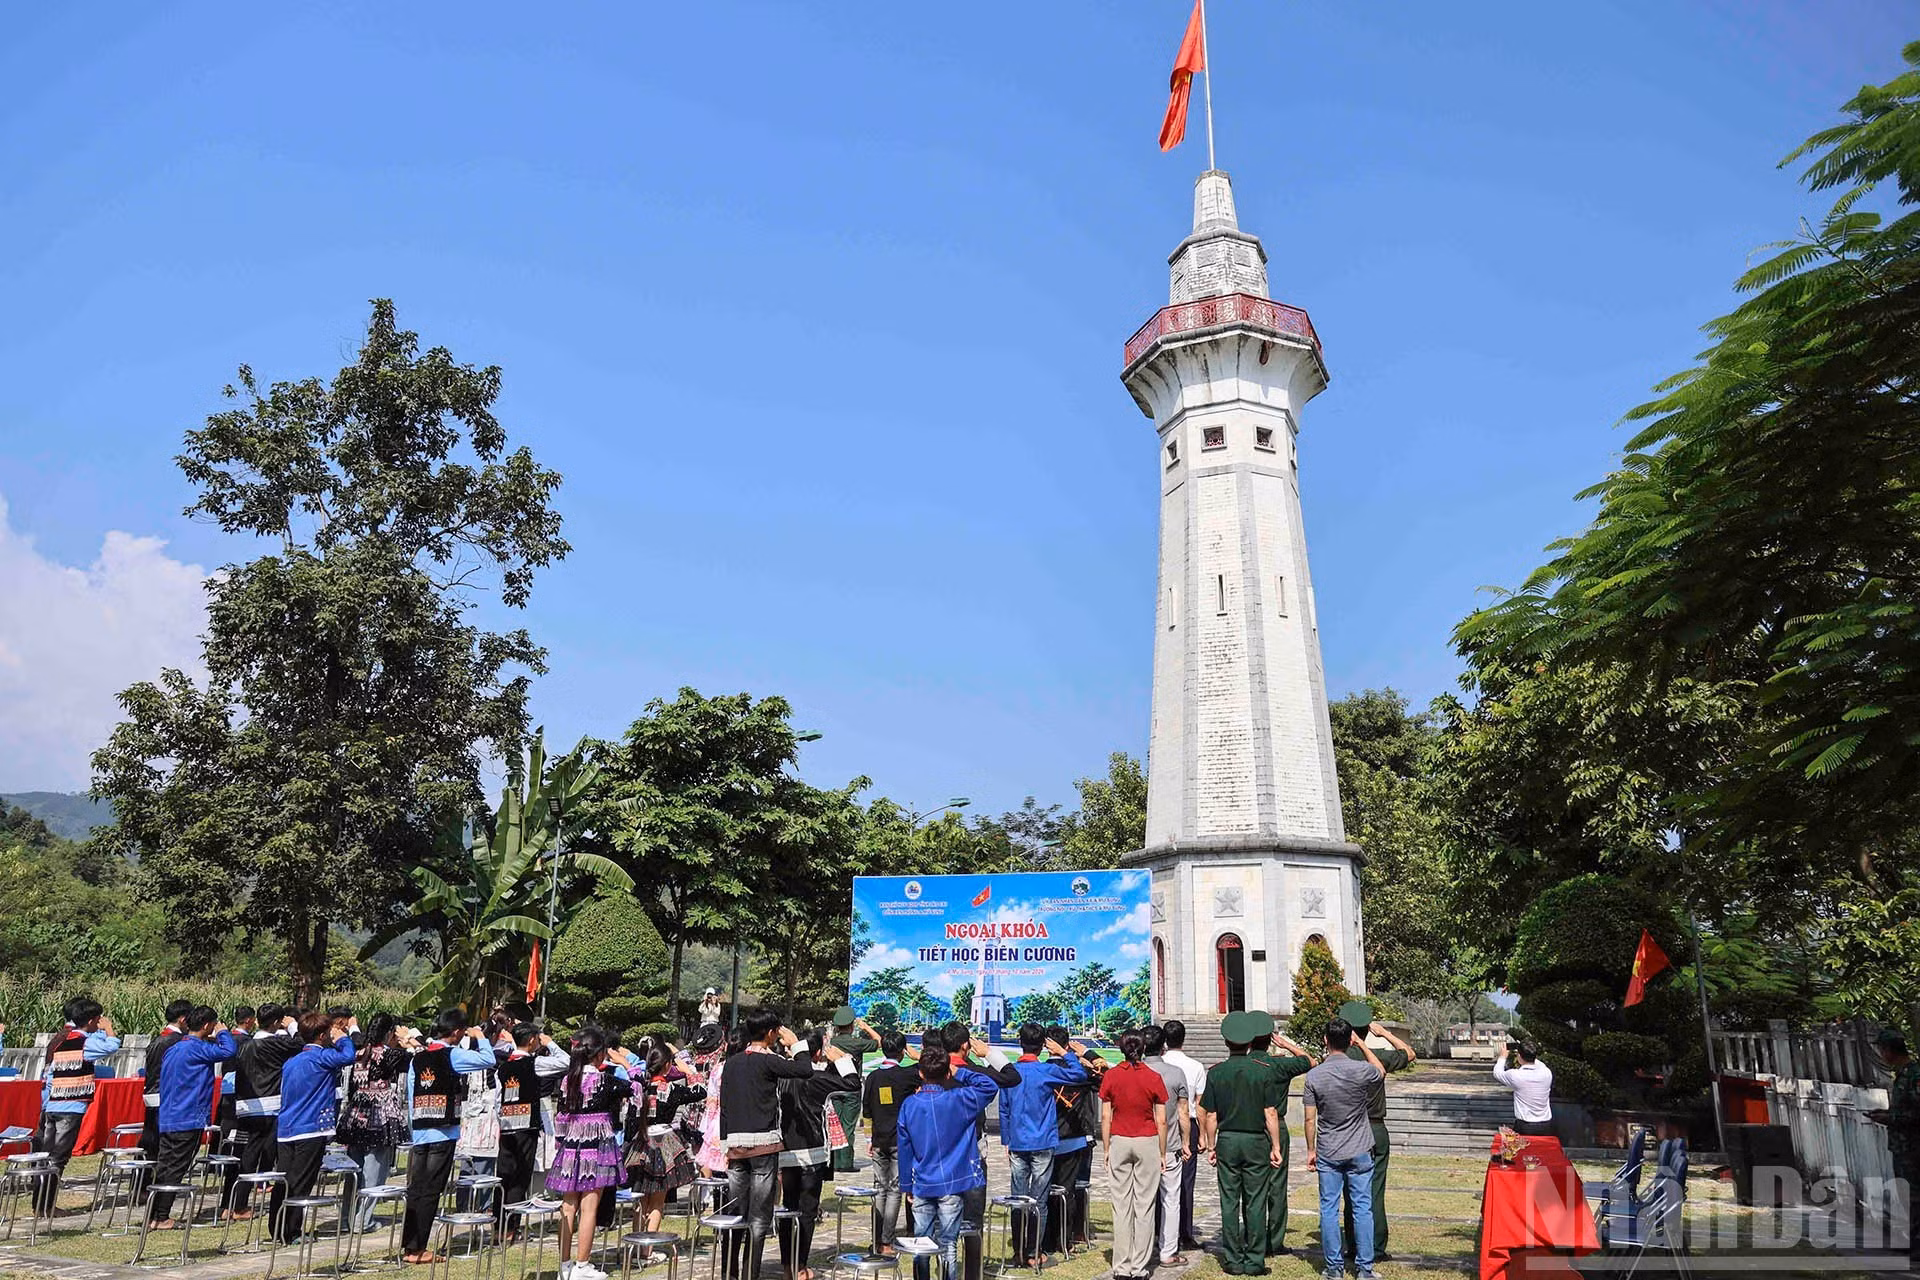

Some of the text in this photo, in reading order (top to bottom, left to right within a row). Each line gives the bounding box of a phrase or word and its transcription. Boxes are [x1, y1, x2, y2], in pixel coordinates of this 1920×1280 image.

[945, 918, 1048, 941] NGOẠI KHÓA
[918, 944, 1076, 965] TIẾT HỌC BIÊN CƯƠNG
